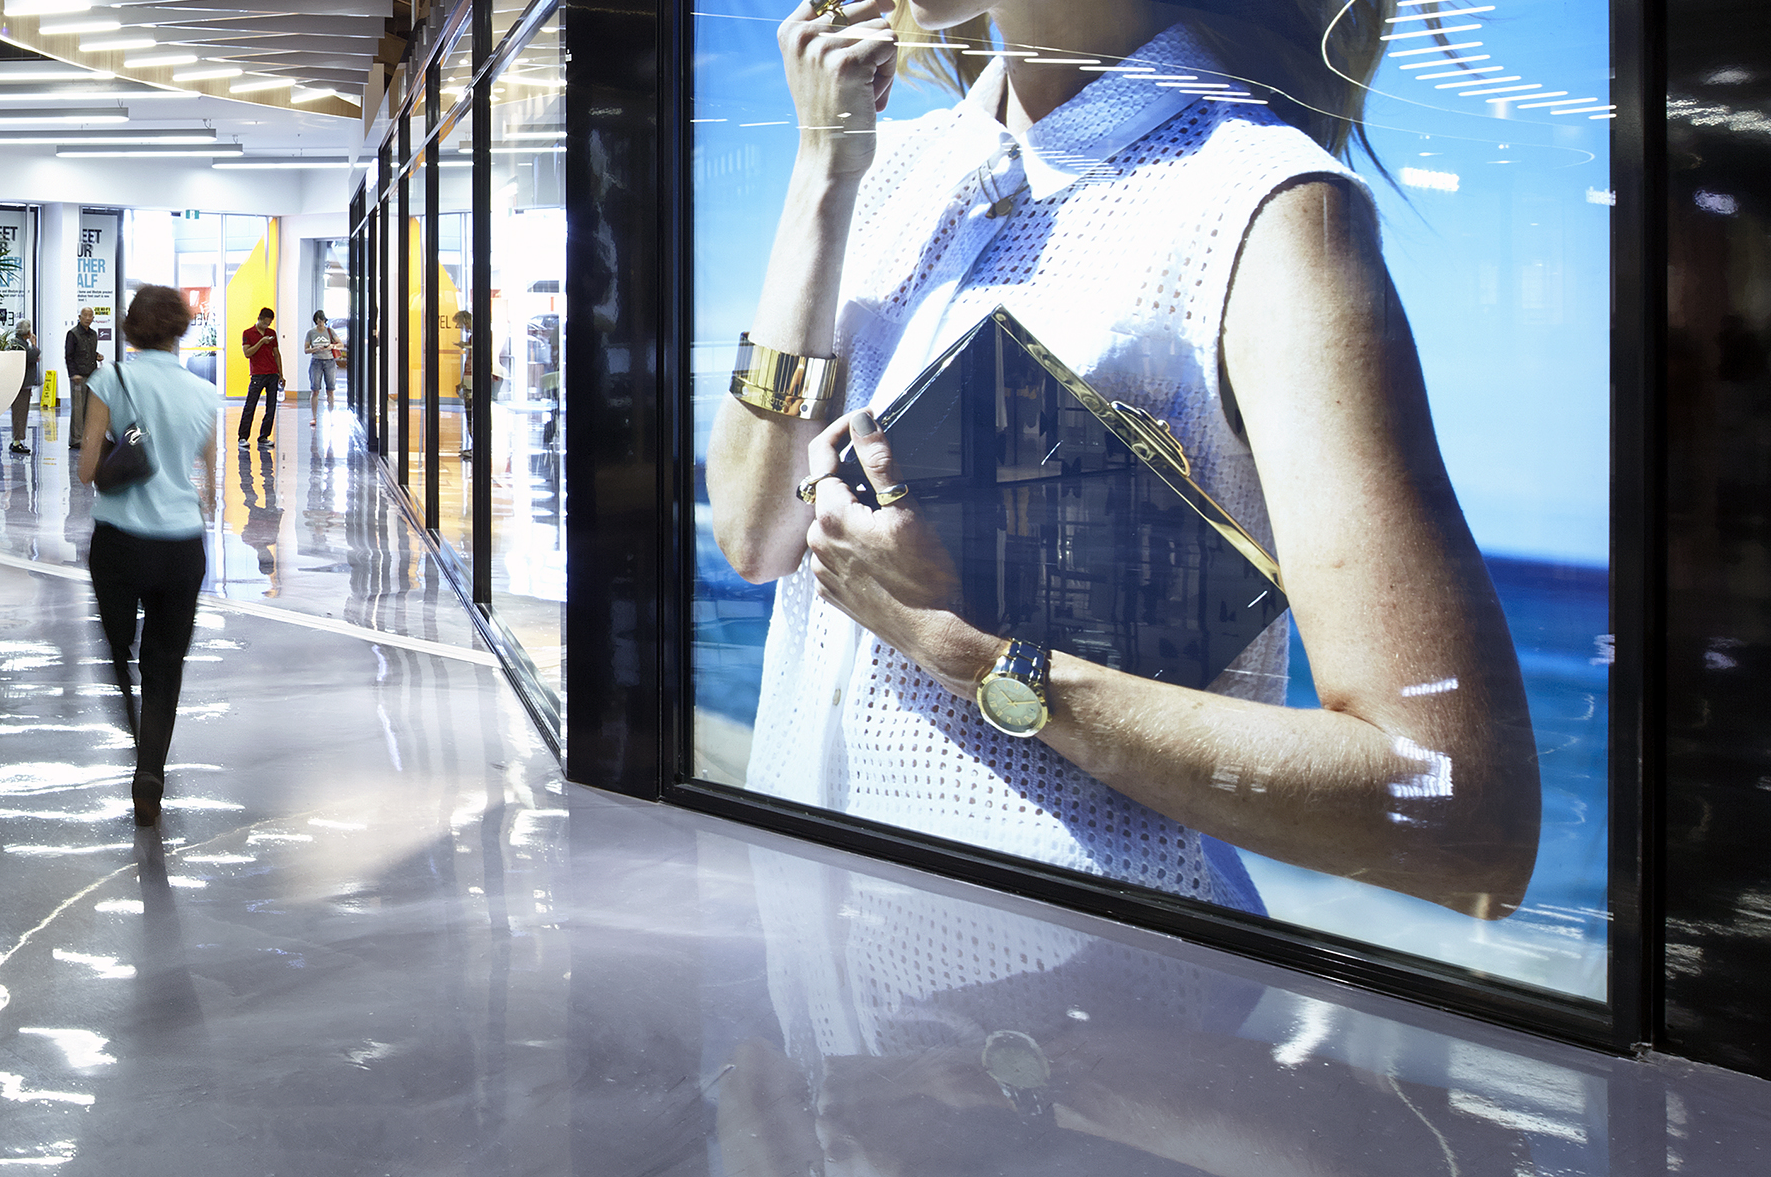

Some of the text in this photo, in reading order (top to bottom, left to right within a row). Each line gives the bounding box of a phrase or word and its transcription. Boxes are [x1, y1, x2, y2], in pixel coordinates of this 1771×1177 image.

[82, 228, 102, 243] EET
[77, 243, 93, 257] UR
[77, 258, 106, 273] THER
[77, 273, 98, 288] ALF
